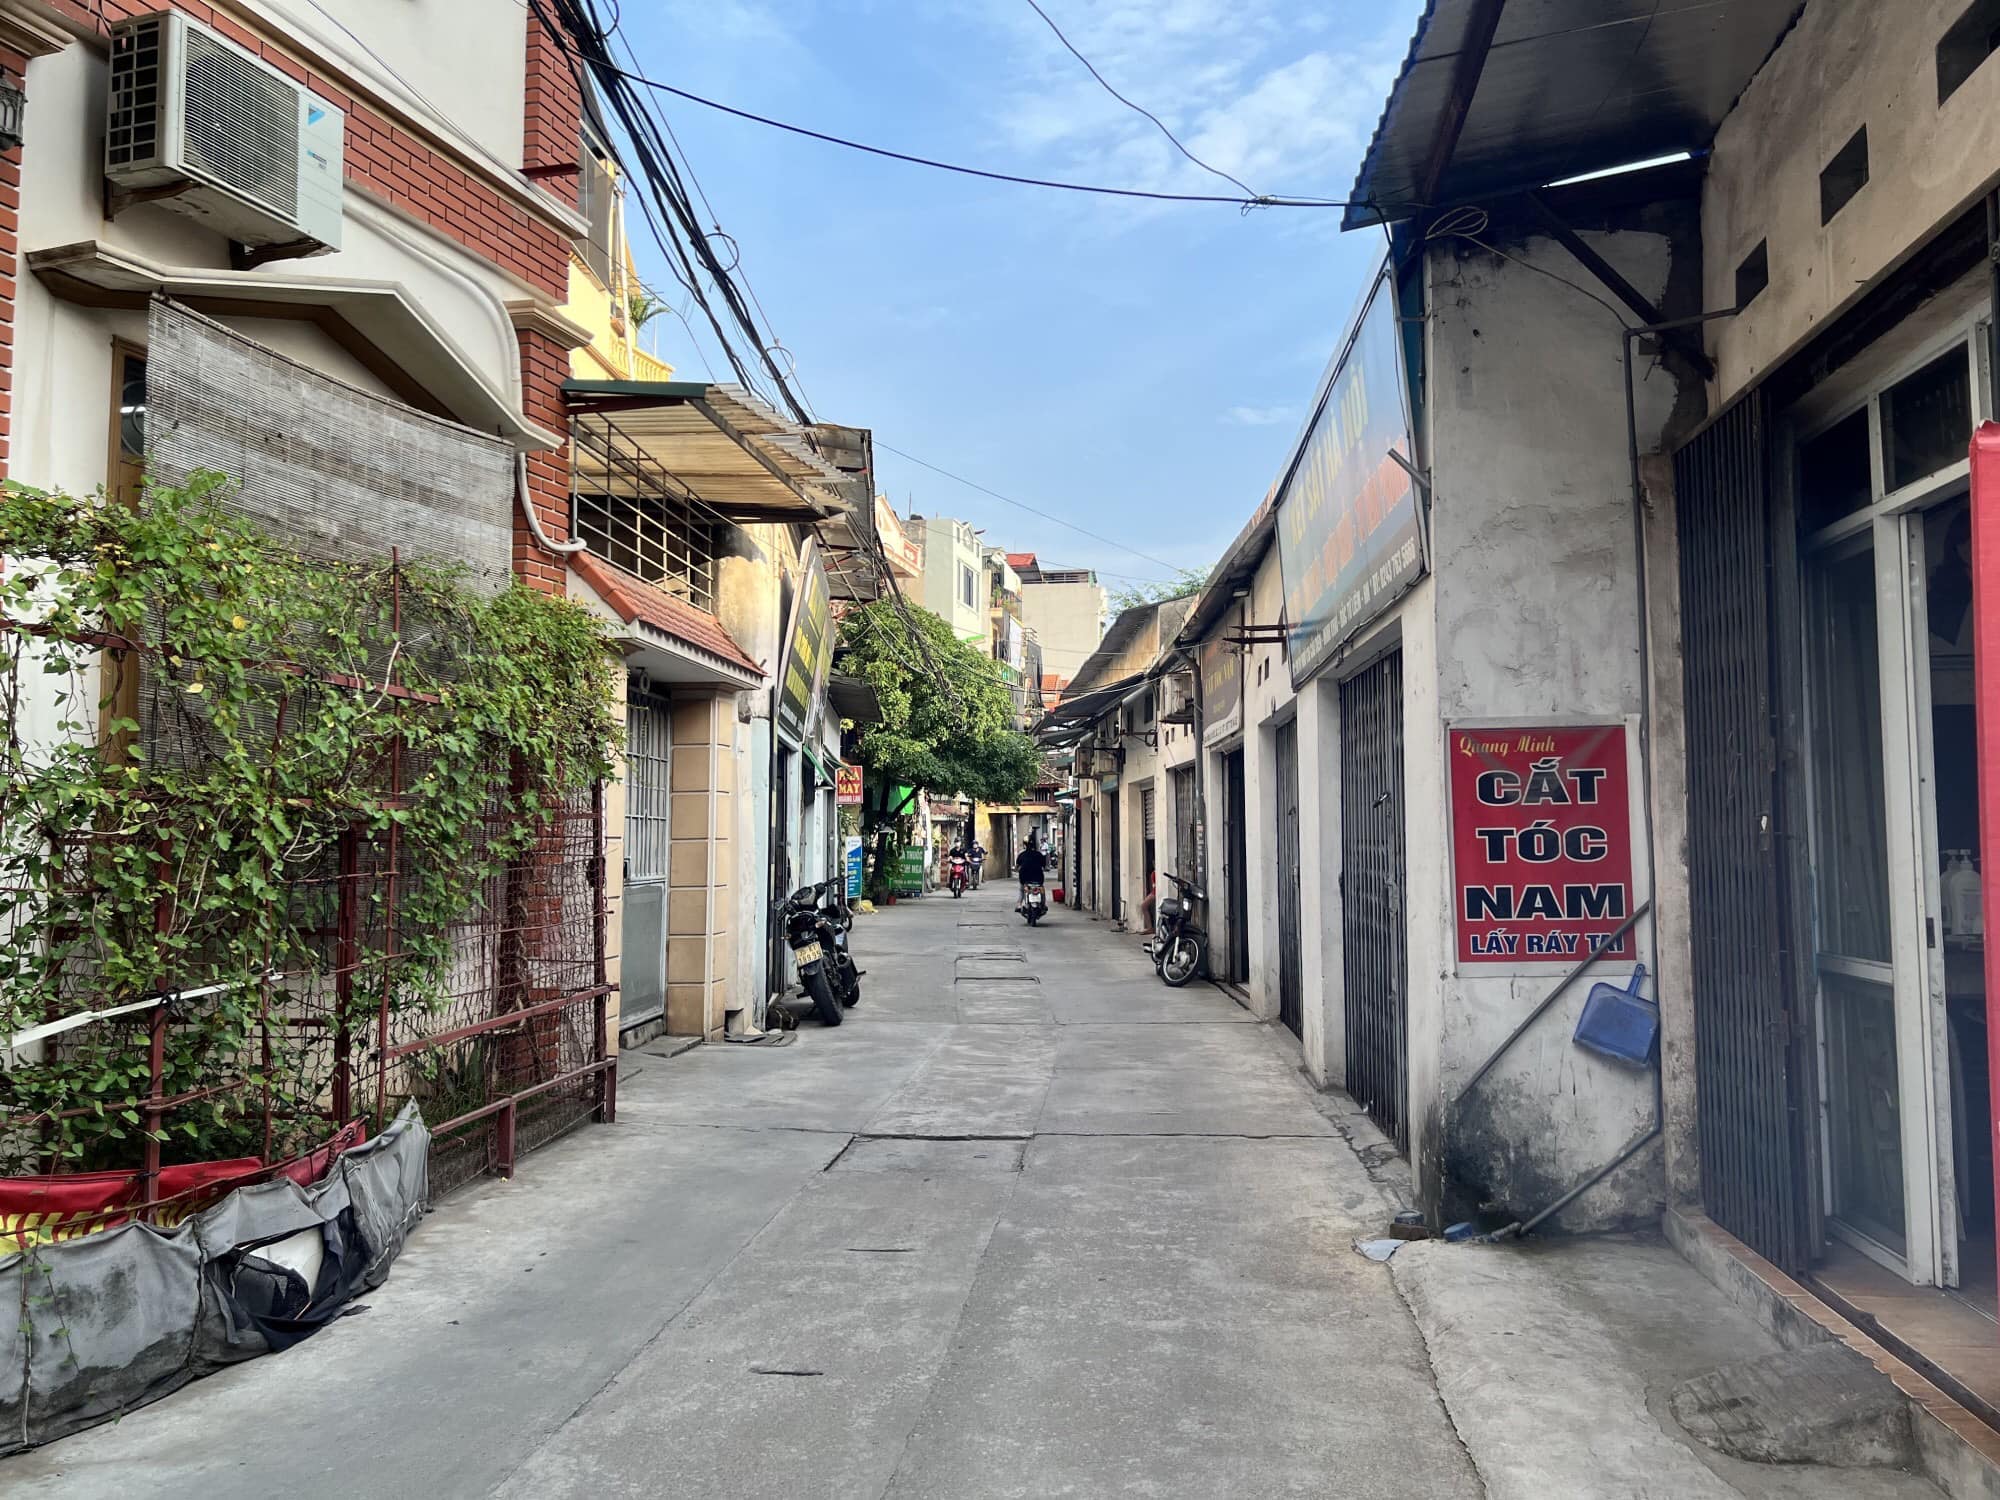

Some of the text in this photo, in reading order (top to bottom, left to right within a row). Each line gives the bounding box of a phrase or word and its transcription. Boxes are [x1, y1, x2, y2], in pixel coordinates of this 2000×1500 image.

[1459, 735, 1556, 757] Quang Minh
[839, 783, 861, 794] MAY
[1475, 756, 1607, 806] CẮT
[1475, 819, 1608, 864] TÓC
[1463, 883, 1626, 921] NAM
[1470, 928, 1625, 955] LẤY RÁY TAI
